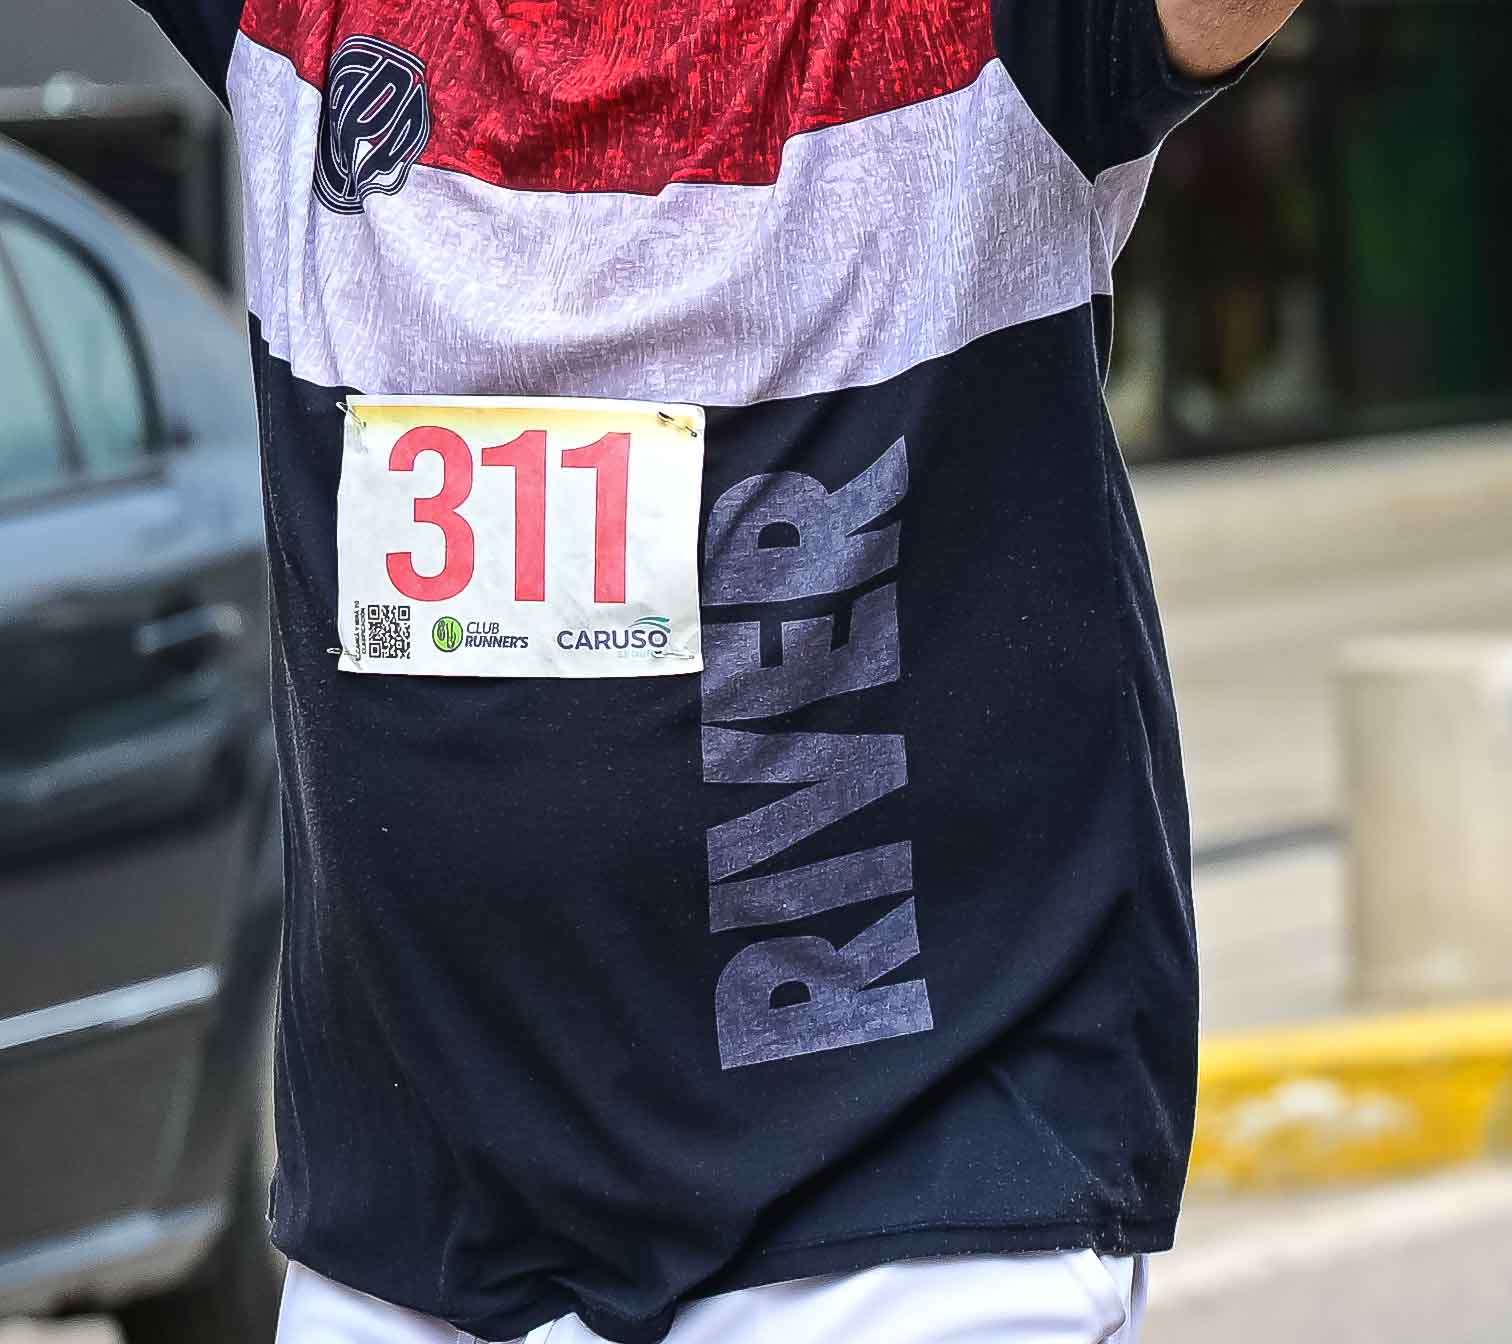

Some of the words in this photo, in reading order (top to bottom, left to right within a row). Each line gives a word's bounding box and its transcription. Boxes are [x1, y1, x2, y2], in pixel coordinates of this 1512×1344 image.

[385, 425, 632, 604] 311
[466, 621, 499, 634] CLUB
[465, 635, 529, 649] RUNNER'S
[556, 629, 668, 650] CARUSO
[701, 436, 934, 1070] RIVER
